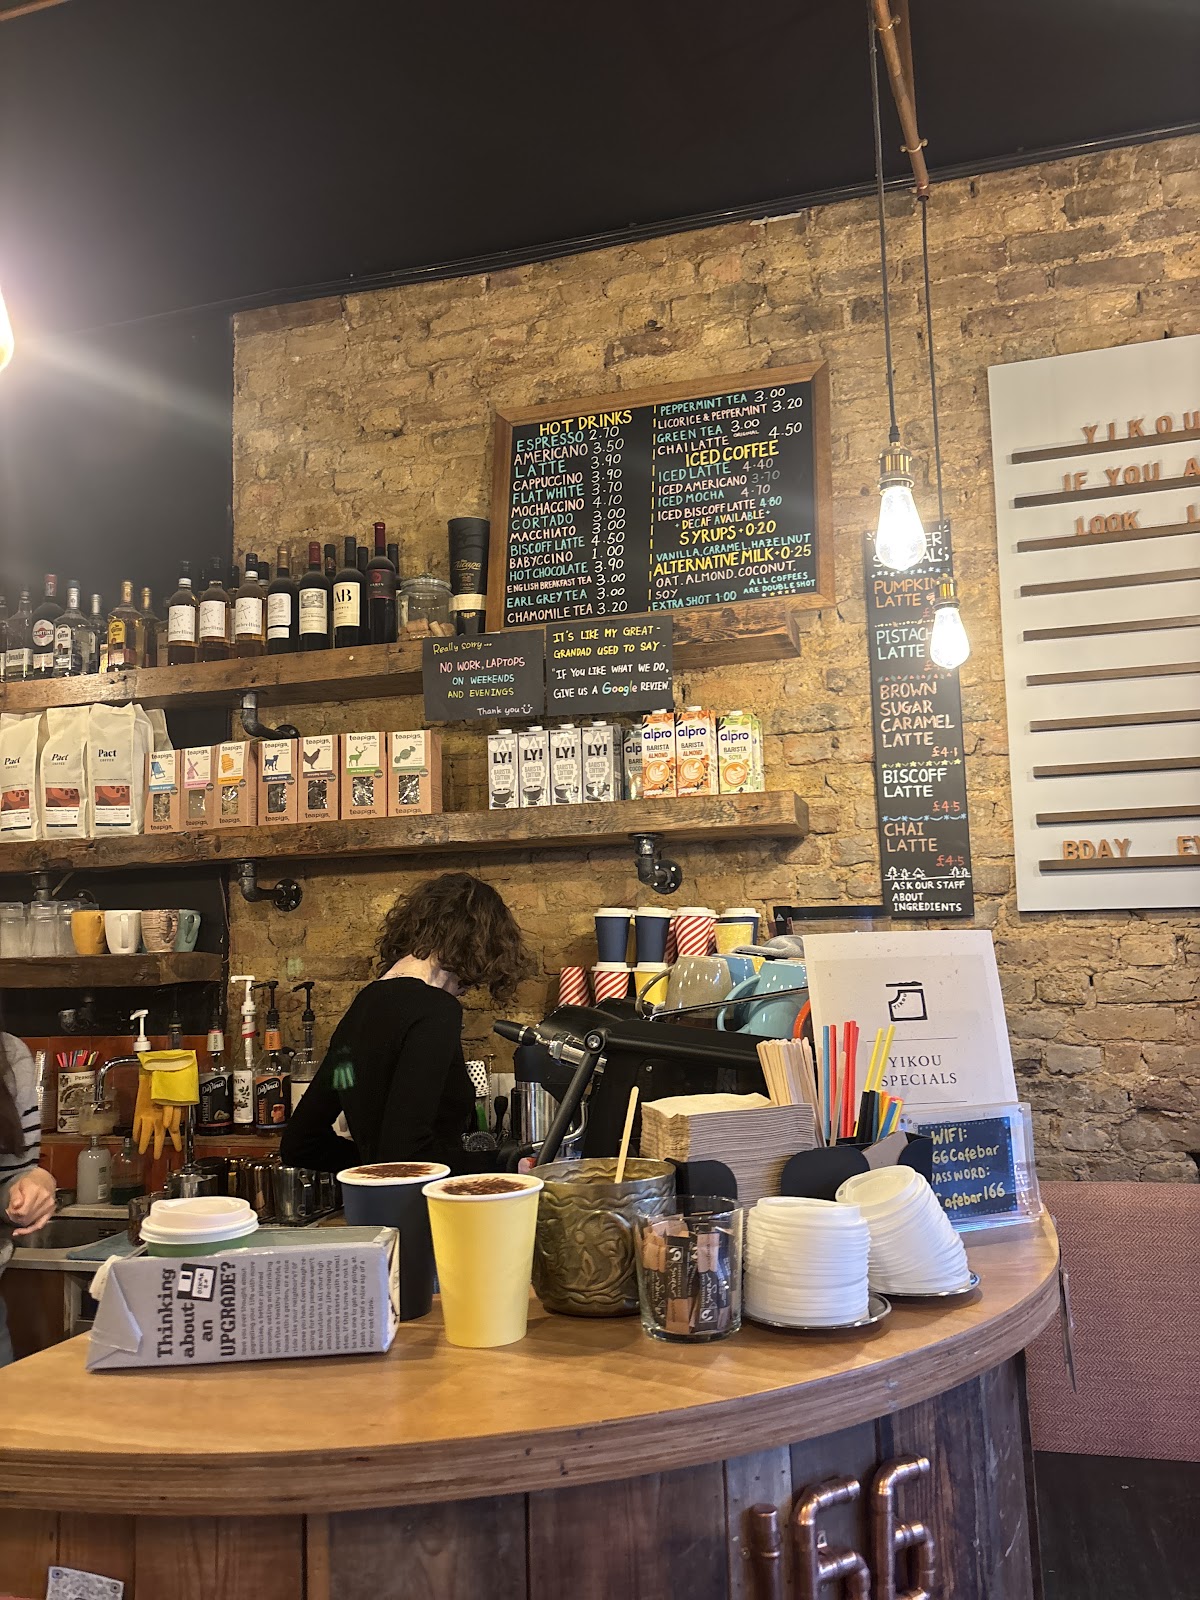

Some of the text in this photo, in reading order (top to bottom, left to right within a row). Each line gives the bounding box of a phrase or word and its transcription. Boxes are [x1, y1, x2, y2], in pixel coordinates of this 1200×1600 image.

[660, 388, 785, 416] PEPPERMINT TEA 3.00
[540, 410, 632, 436] HOT DRINKS
[658, 398, 802, 429] LICORICE PEPPERMINT 3.20
[657, 419, 760, 443] GREEN TEA 3.00
[1083, 411, 1200, 443] YIKOU
[517, 426, 619, 452] ESPRESSO 2.70
[658, 422, 802, 455] CHAI LATTE 4.50
[514, 438, 624, 466] AMERICANO 3.50
[686, 440, 779, 467] ICED COFFEE
[516, 454, 621, 478] LATTE 3.90
[659, 462, 731, 482] ICED LATTE
[513, 469, 622, 491] CAPPUCCINO 3.90
[659, 475, 747, 495] ICED AMERICANO
[1063, 472, 1087, 492] IF
[1105, 463, 1160, 486] YOU
[513, 482, 622, 504] FLAT WHITE 3.70
[658, 489, 724, 507] ICED MOCHA
[511, 495, 622, 518] MOCHACCINO 4.10
[658, 499, 756, 521] ICED BISCOFF LATTE
[512, 508, 625, 530] CORTADO 3.00
[682, 509, 765, 530] DECAF AVAILABLE
[1076, 511, 1138, 536] LOOK
[510, 520, 625, 543] MACCHIATO 3.00
[679, 526, 735, 545] SYRUPS
[510, 532, 625, 556] BISCOFF LATTE 4.50
[510, 545, 624, 568] BABYCCINO 1.00
[654, 547, 774, 576] ALTERNATIVE MILK
[510, 558, 624, 581] HOT CHOCOLATE 3.90
[771, 572, 808, 582] COFFEES
[507, 573, 625, 593] ENGLISH BREAKFAST TEA 3.00
[762, 583, 794, 592] DOUBLE
[796, 579, 815, 587] SHOT
[507, 588, 625, 608] EARL GREY TEA 3.00
[652, 594, 711, 611] EXTRA SHOT
[656, 589, 678, 599] SOY
[876, 593, 921, 609] LATTE
[508, 601, 627, 623] CHAMOMILE TEA 3.20
[553, 629, 617, 643] IT'S LIKE MY
[433, 642, 458, 654] Really
[554, 647, 591, 659] GRANDAD
[597, 646, 618, 655] USED
[877, 644, 925, 660] LATTE
[440, 663, 452, 673] NO
[486, 657, 525, 668] LAPTOPS
[588, 666, 606, 675] LIKE
[611, 664, 633, 673] WHAT
[638, 664, 650, 672] WE
[453, 674, 514, 685] ON WEEKENDS
[469, 688, 514, 697] EVENINGS
[554, 688, 574, 699] GIVE
[592, 685, 598, 694] A
[602, 680, 637, 696] Google
[880, 681, 937, 700] BROWN
[477, 706, 502, 715] Thank
[880, 699, 933, 716] SUGAR
[678, 726, 706, 738] alpro
[881, 714, 955, 733] CARAMEL
[644, 729, 672, 741] alpro
[720, 730, 749, 742] alpro
[882, 732, 934, 748] LATTE
[98, 749, 116, 757] Pact
[493, 752, 512, 763] LY!
[524, 749, 543, 760] LY!
[556, 747, 575, 758] LY!
[588, 744, 607, 756] LY!
[4, 757, 21, 765] Pact
[883, 768, 947, 784] BISCOFF
[883, 785, 933, 798] LATTE
[884, 822, 924, 836] CHAI
[886, 838, 938, 852] LATTE
[1063, 839, 1129, 860] BDAY
[892, 881, 965, 890] ASK OUR STAFF
[892, 893, 924, 902] ABOUT
[894, 903, 962, 911] INGREDIENTS
[888, 1055, 941, 1067] YIKOU
[881, 1073, 957, 1086] SPECIALS
[931, 1128, 967, 1145] WIFI:
[932, 1145, 999, 1164] 66Cafebar
[157, 1268, 175, 1357] Thinking
[221, 1262, 235, 1356] UPGRADE?
[180, 1302, 194, 1358] about
[203, 1320, 213, 1341] an
